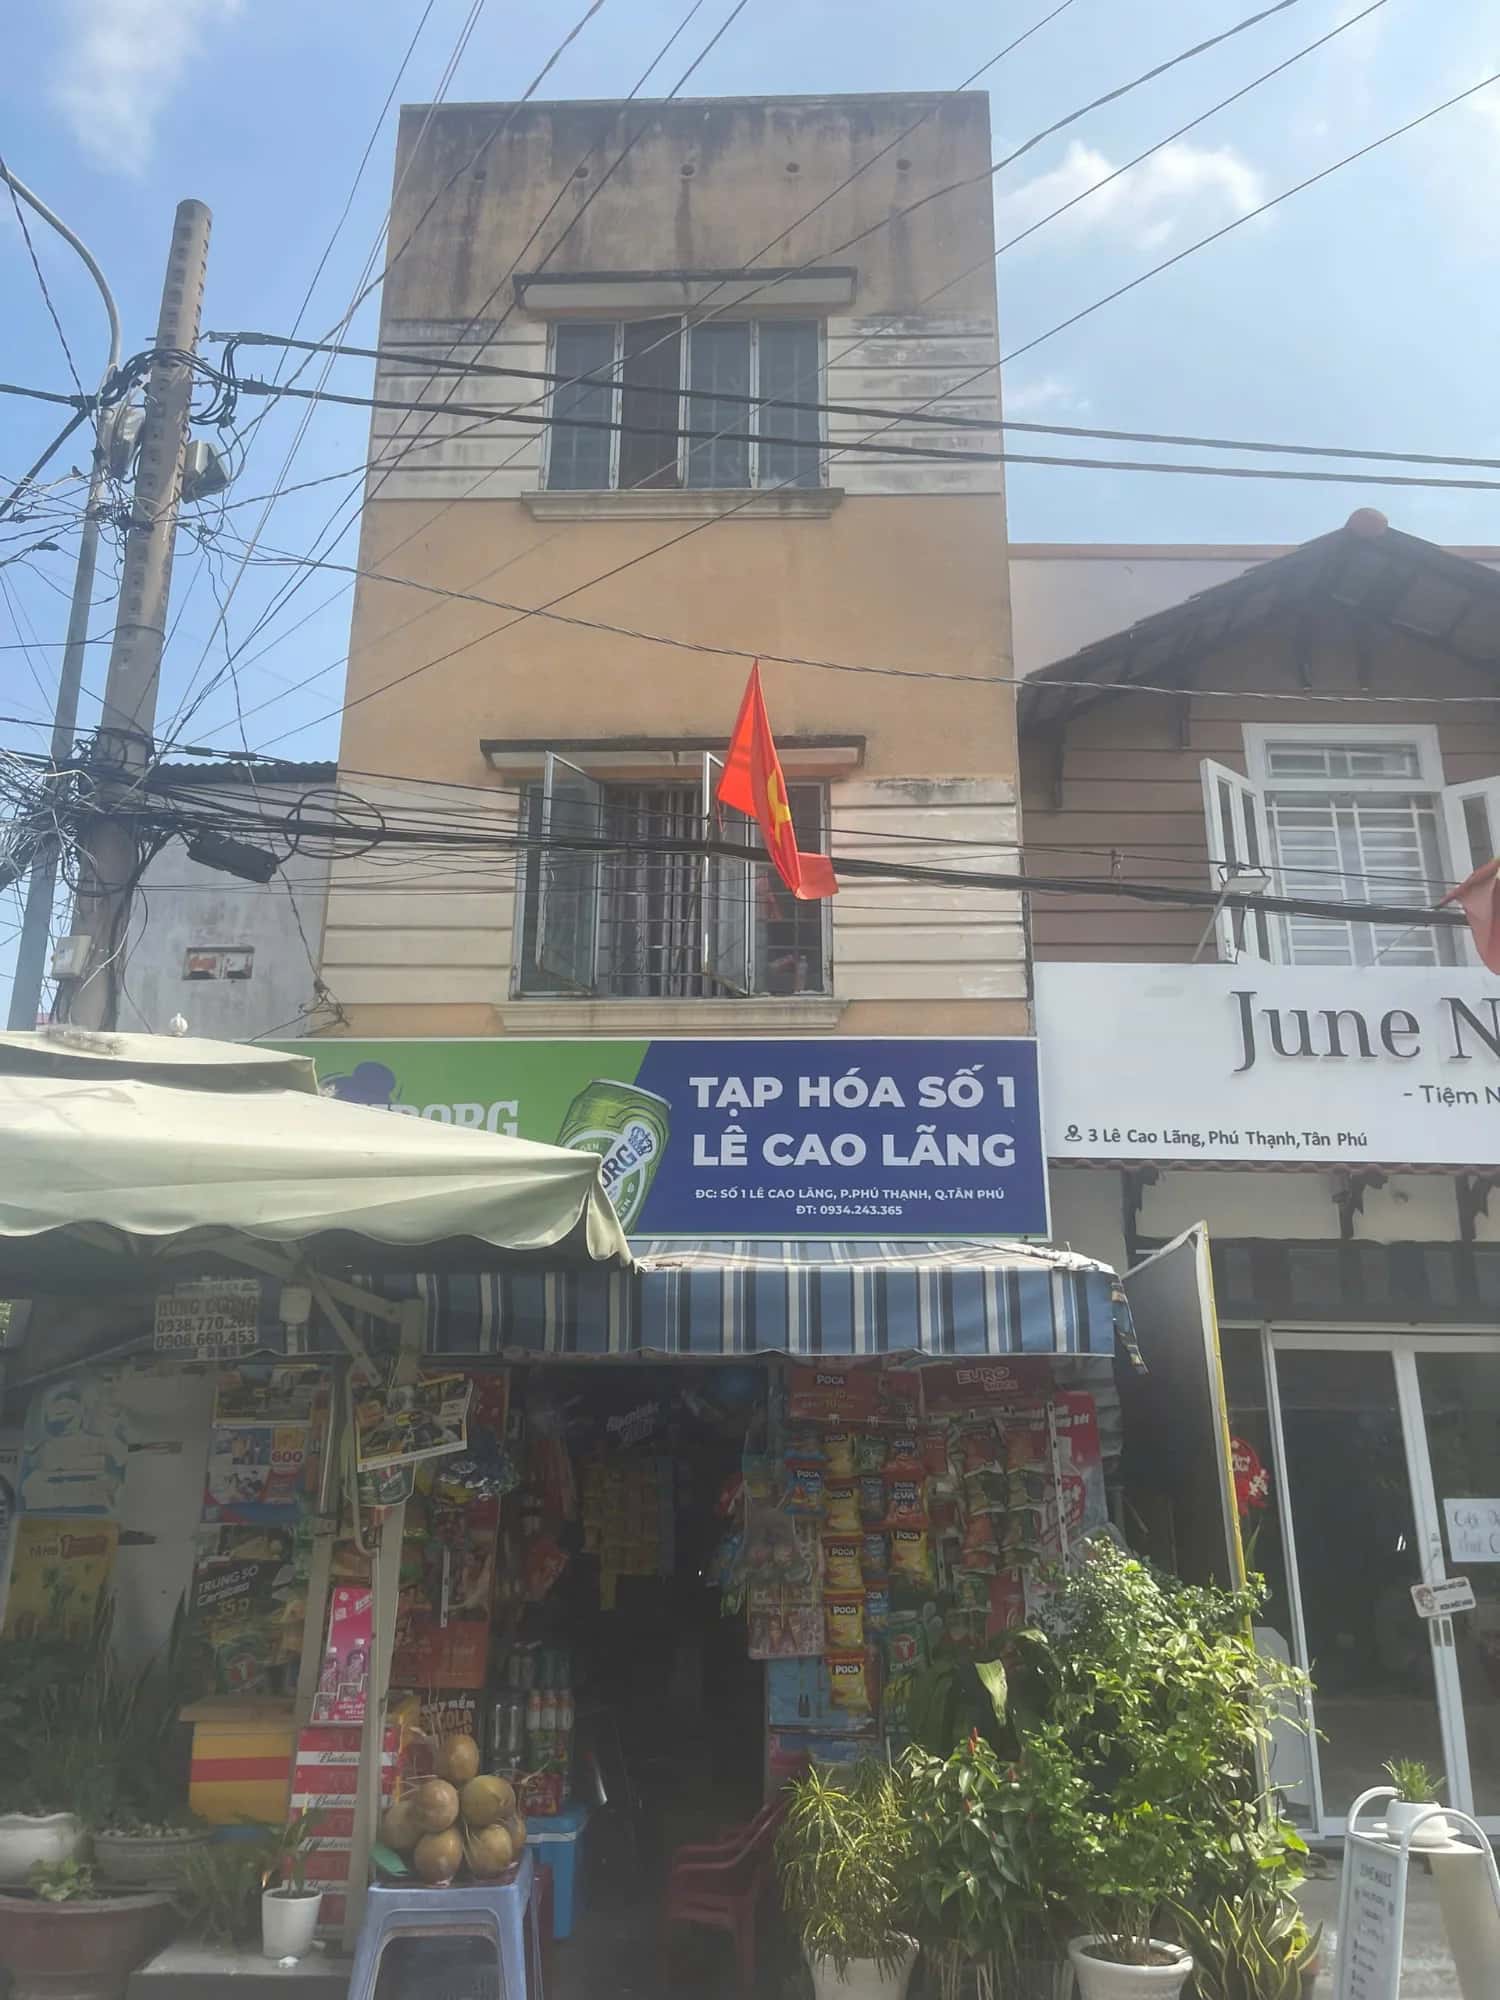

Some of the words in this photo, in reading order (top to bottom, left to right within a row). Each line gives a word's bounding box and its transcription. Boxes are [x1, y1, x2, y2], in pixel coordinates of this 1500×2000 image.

[1230, 990, 1421, 1072] June
[689, 1076, 783, 1117] TẠP
[798, 1067, 905, 1108] HÓA
[917, 1063, 984, 1108] SỐ
[997, 1076, 1015, 1108] 1
[1419, 1085, 1478, 1108] Tiệm
[1088, 1128, 1098, 1142] 3
[1103, 1128, 1121, 1143] Lê
[1127, 1129, 1158, 1144] Cao
[1337, 1132, 1368, 1146] Phú
[692, 1125, 748, 1167] LÊ
[762, 1133, 866, 1167] CAO
[882, 1124, 1016, 1167] LÃNG
[695, 1189, 717, 1199] ĐC:
[720, 1185, 738, 1199] SỐ
[741, 1189, 746, 1199] 1
[750, 1186, 765, 1199] LÊ
[768, 1188, 795, 1199] CAO
[799, 1186, 837, 1200] LÃNG,
[840, 1186, 879, 1199] P.PHÚ
[882, 1189, 932, 1201] THẠNH,
[935, 1186, 973, 1200] Q.TÂN
[977, 1186, 1005, 1199] PHÚ
[796, 1205, 816, 1215] ĐT:
[820, 1204, 903, 1215] 0934.243.365
[816, 1374, 845, 1385] POCA
[956, 1367, 1010, 1385] EURO
[797, 1470, 820, 1479] POCA
[897, 1531, 919, 1540] POCA
[832, 1548, 855, 1556] POCA
[833, 1606, 857, 1614] POCA
[835, 1664, 859, 1674] POCA
